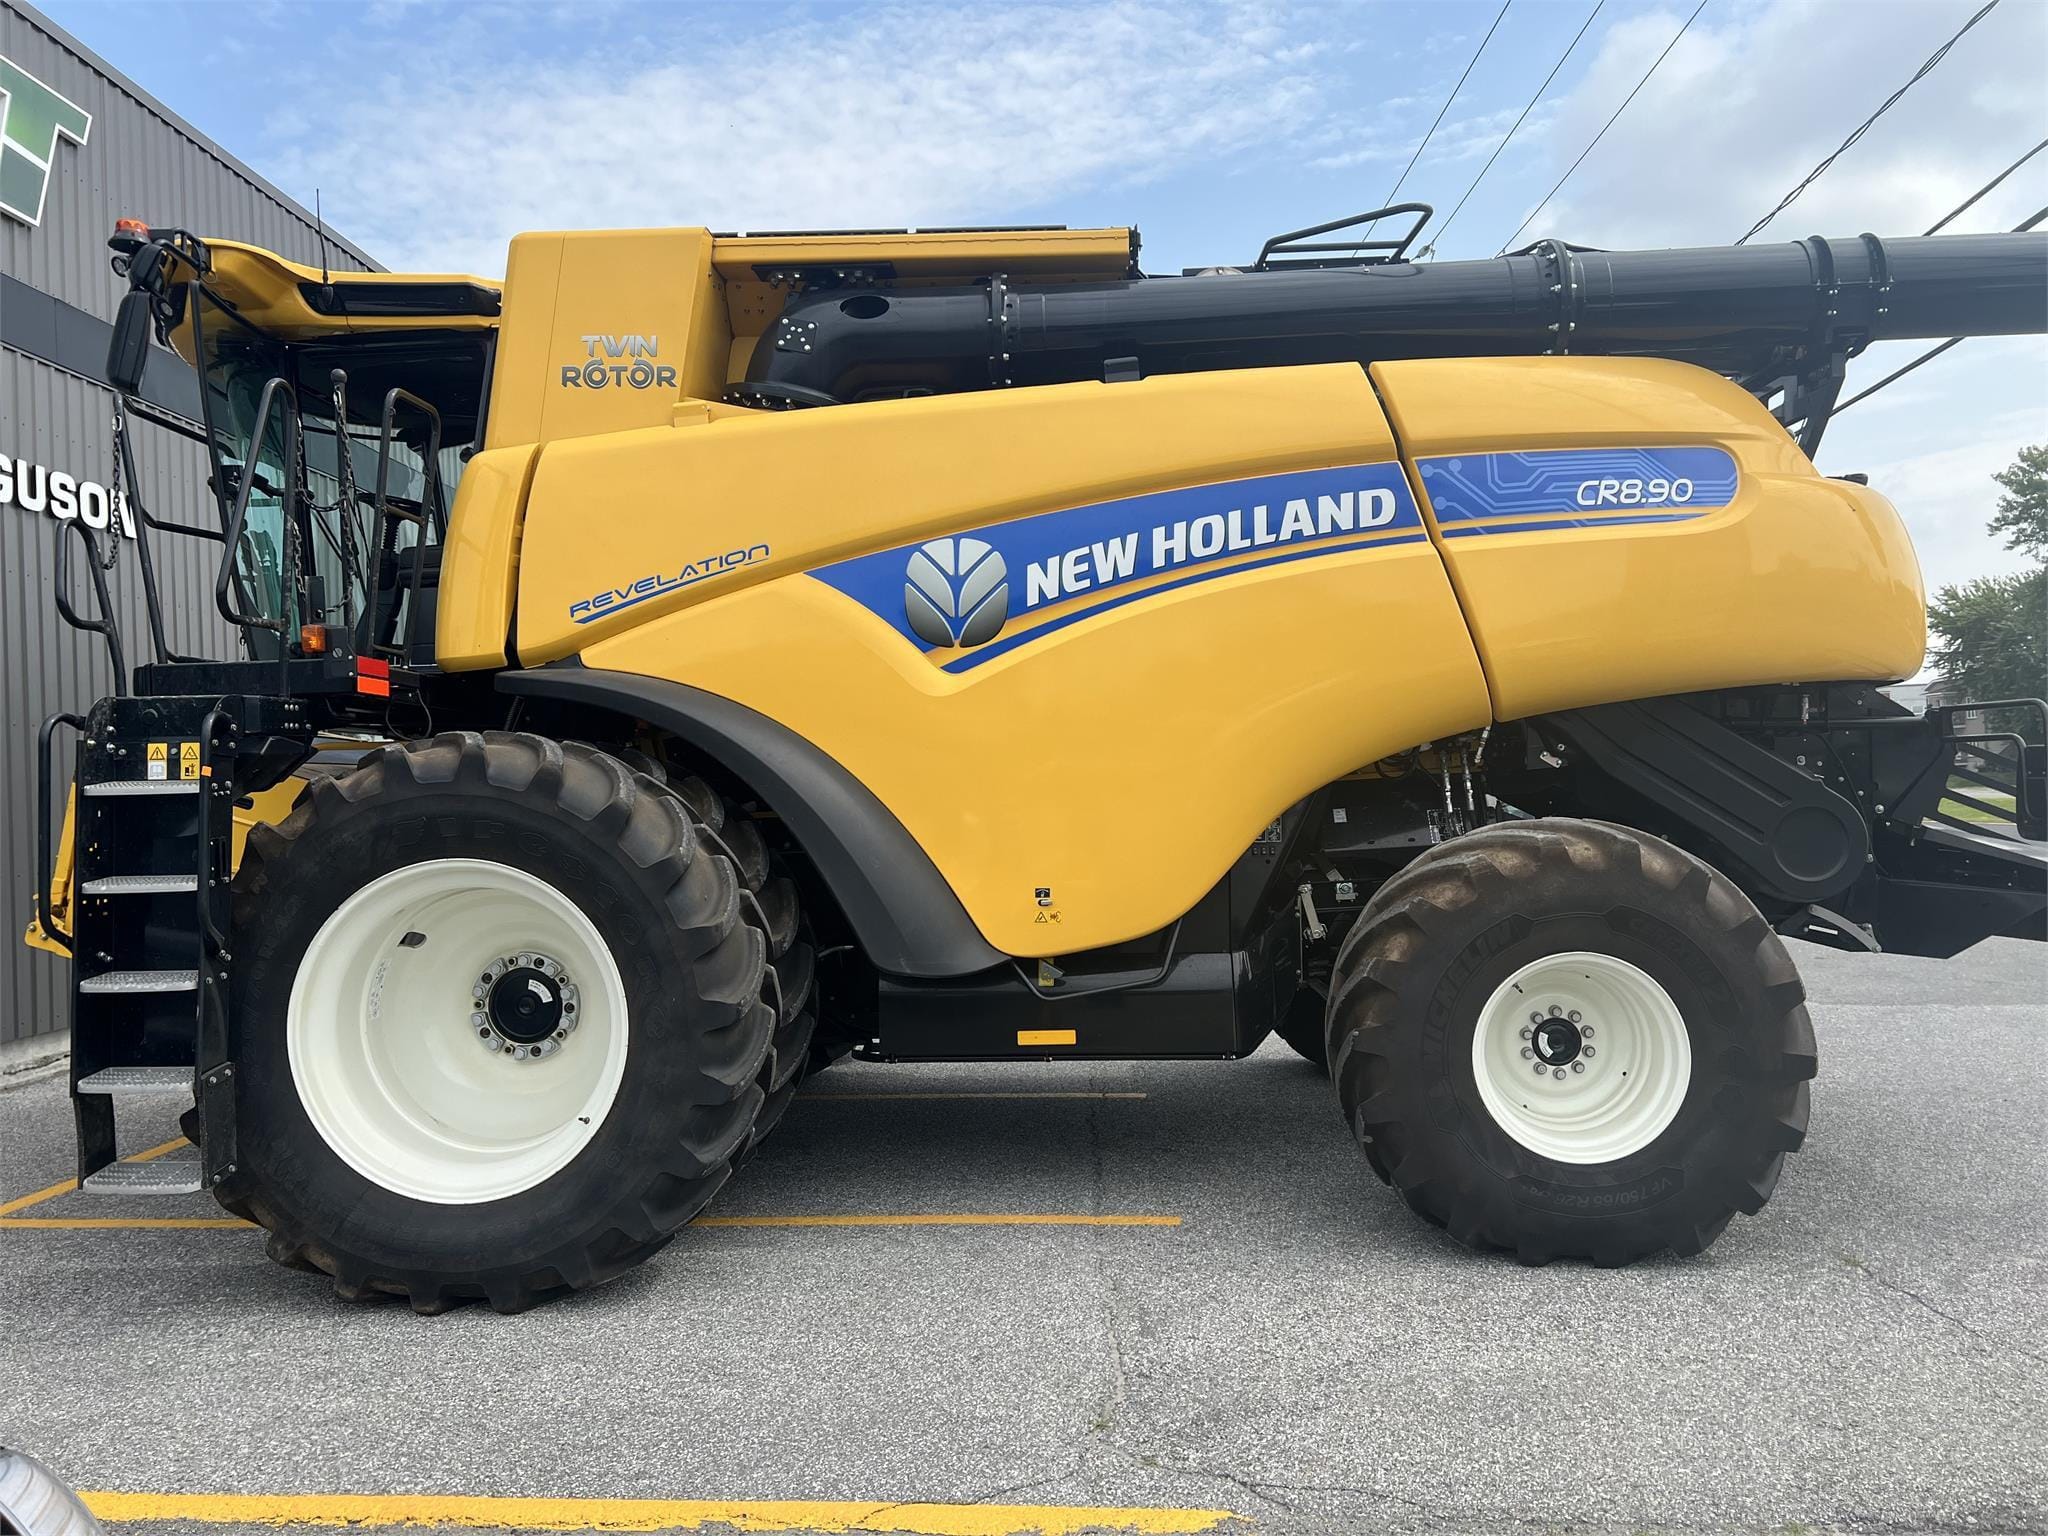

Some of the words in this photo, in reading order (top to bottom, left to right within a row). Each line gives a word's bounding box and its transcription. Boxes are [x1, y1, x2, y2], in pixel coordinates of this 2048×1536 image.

[581, 335, 658, 357] TWIN
[561, 358, 678, 390] ROTOR
[1577, 478, 1694, 506] CR8.90
[1026, 532, 1139, 608] NEW
[1152, 488, 1397, 569] HOLLAND
